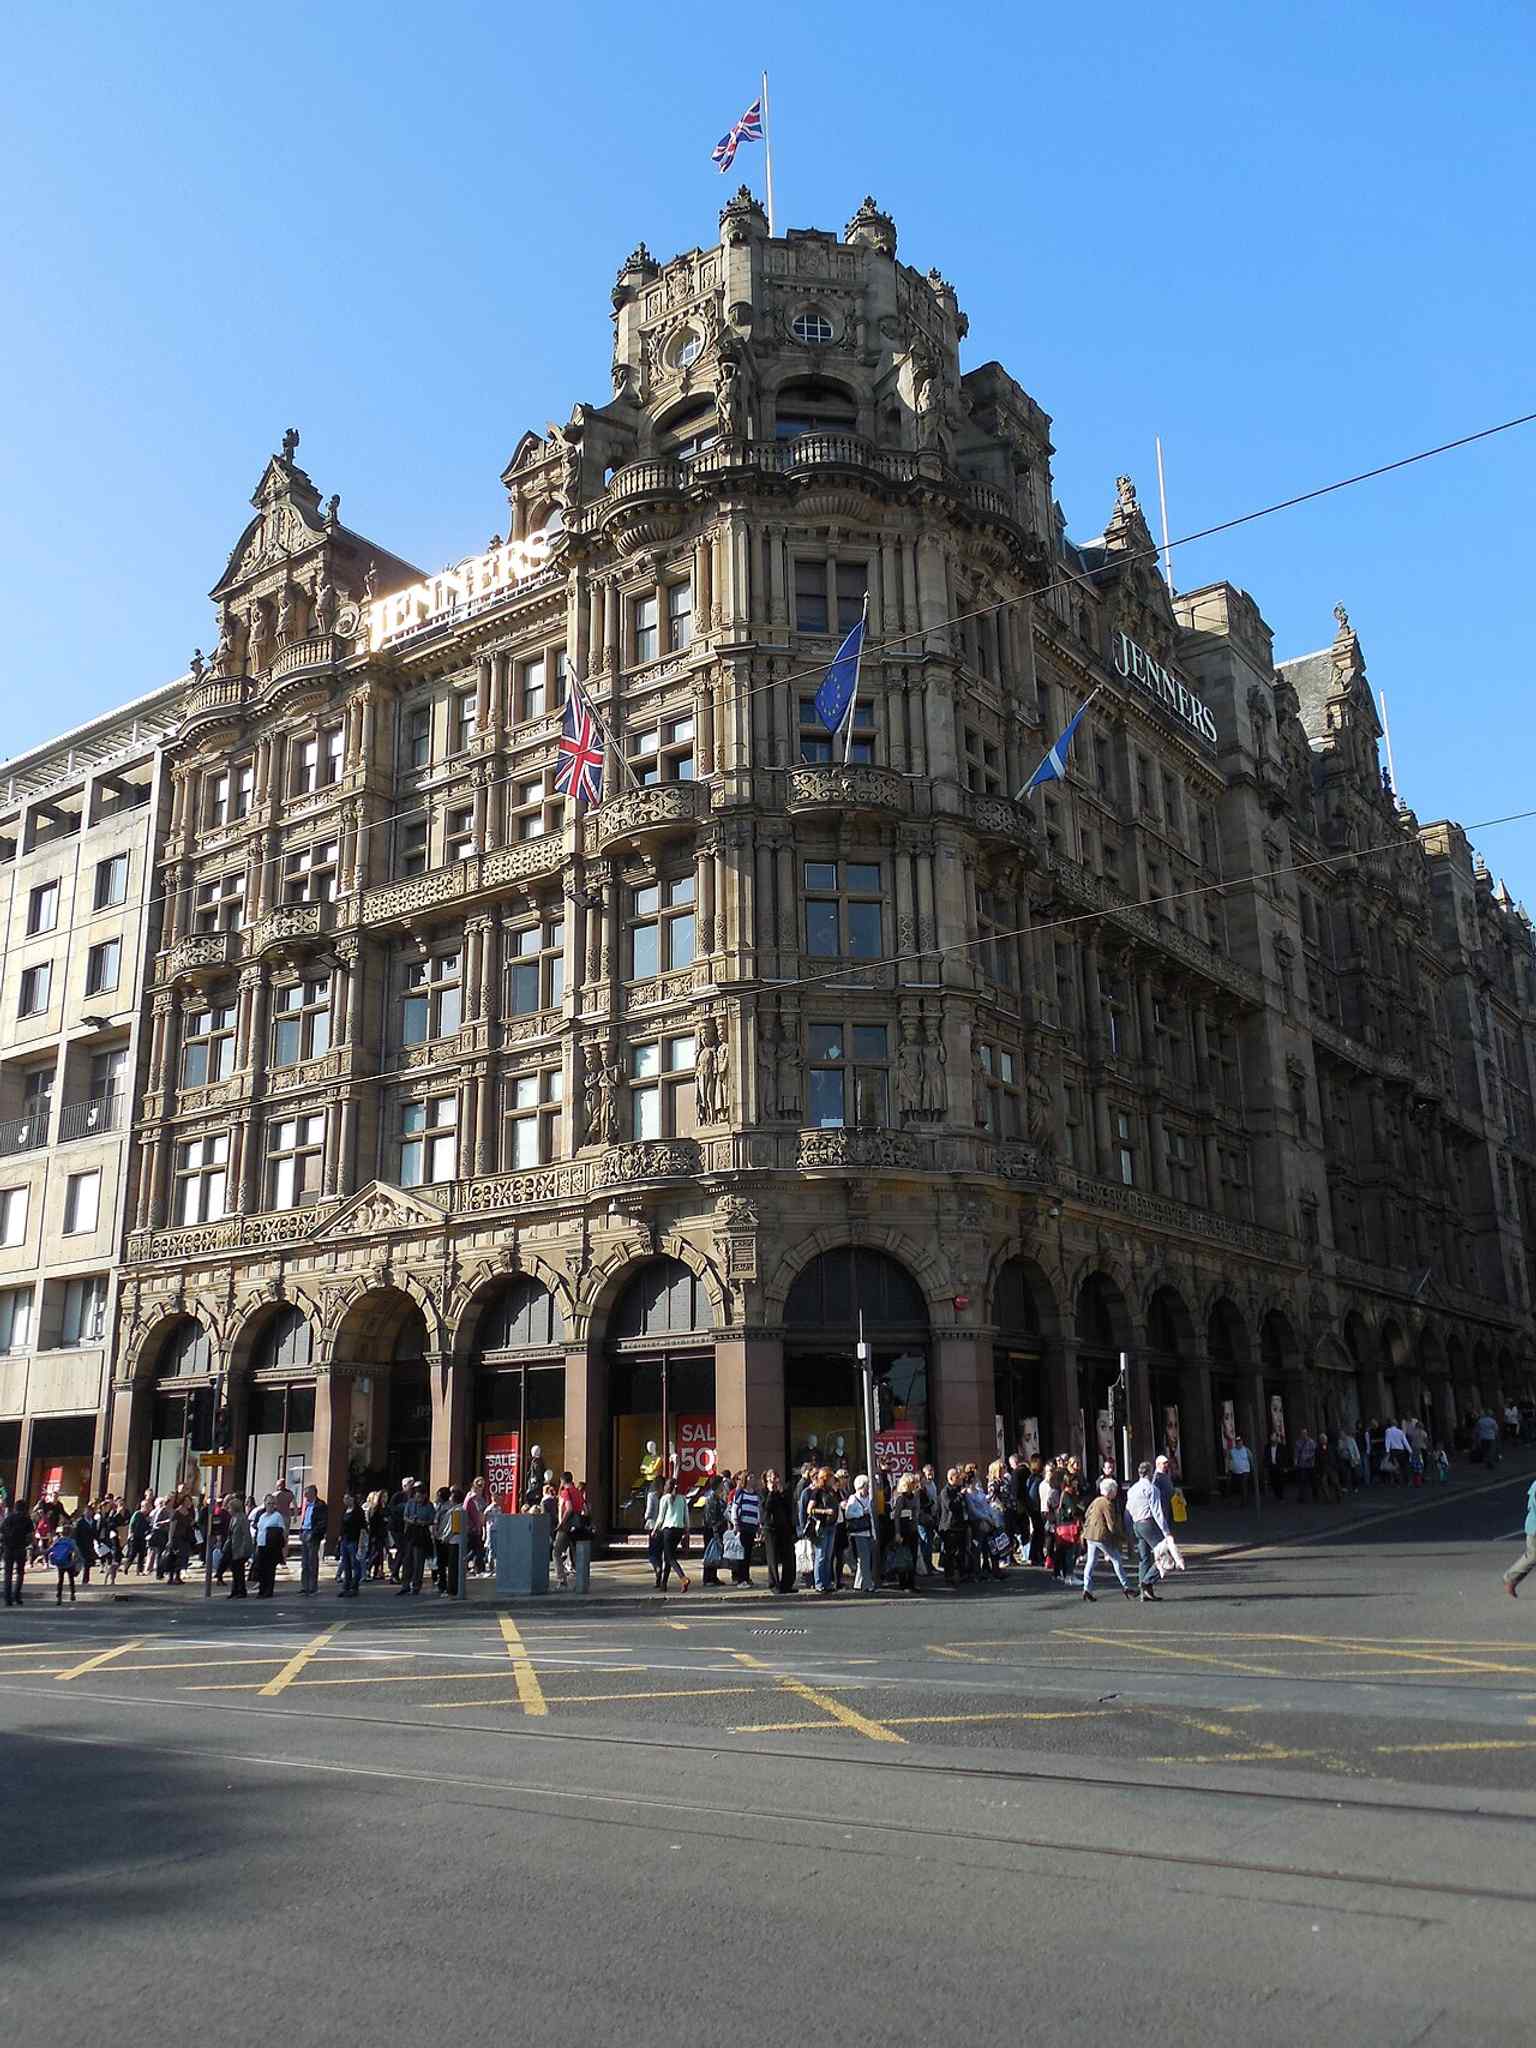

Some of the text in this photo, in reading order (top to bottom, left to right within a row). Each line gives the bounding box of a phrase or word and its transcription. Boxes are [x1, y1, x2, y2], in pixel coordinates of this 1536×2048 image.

[367, 529, 550, 652] JENNERS
[1112, 631, 1217, 742] JENNERS
[682, 1423, 716, 1442] SAL
[874, 1441, 914, 1455] SALE
[487, 1454, 517, 1467] SALE
[681, 1447, 717, 1472] 50
[876, 1457, 913, 1472] 0%
[489, 1468, 514, 1482] 50%
[490, 1482, 513, 1495] OFF
